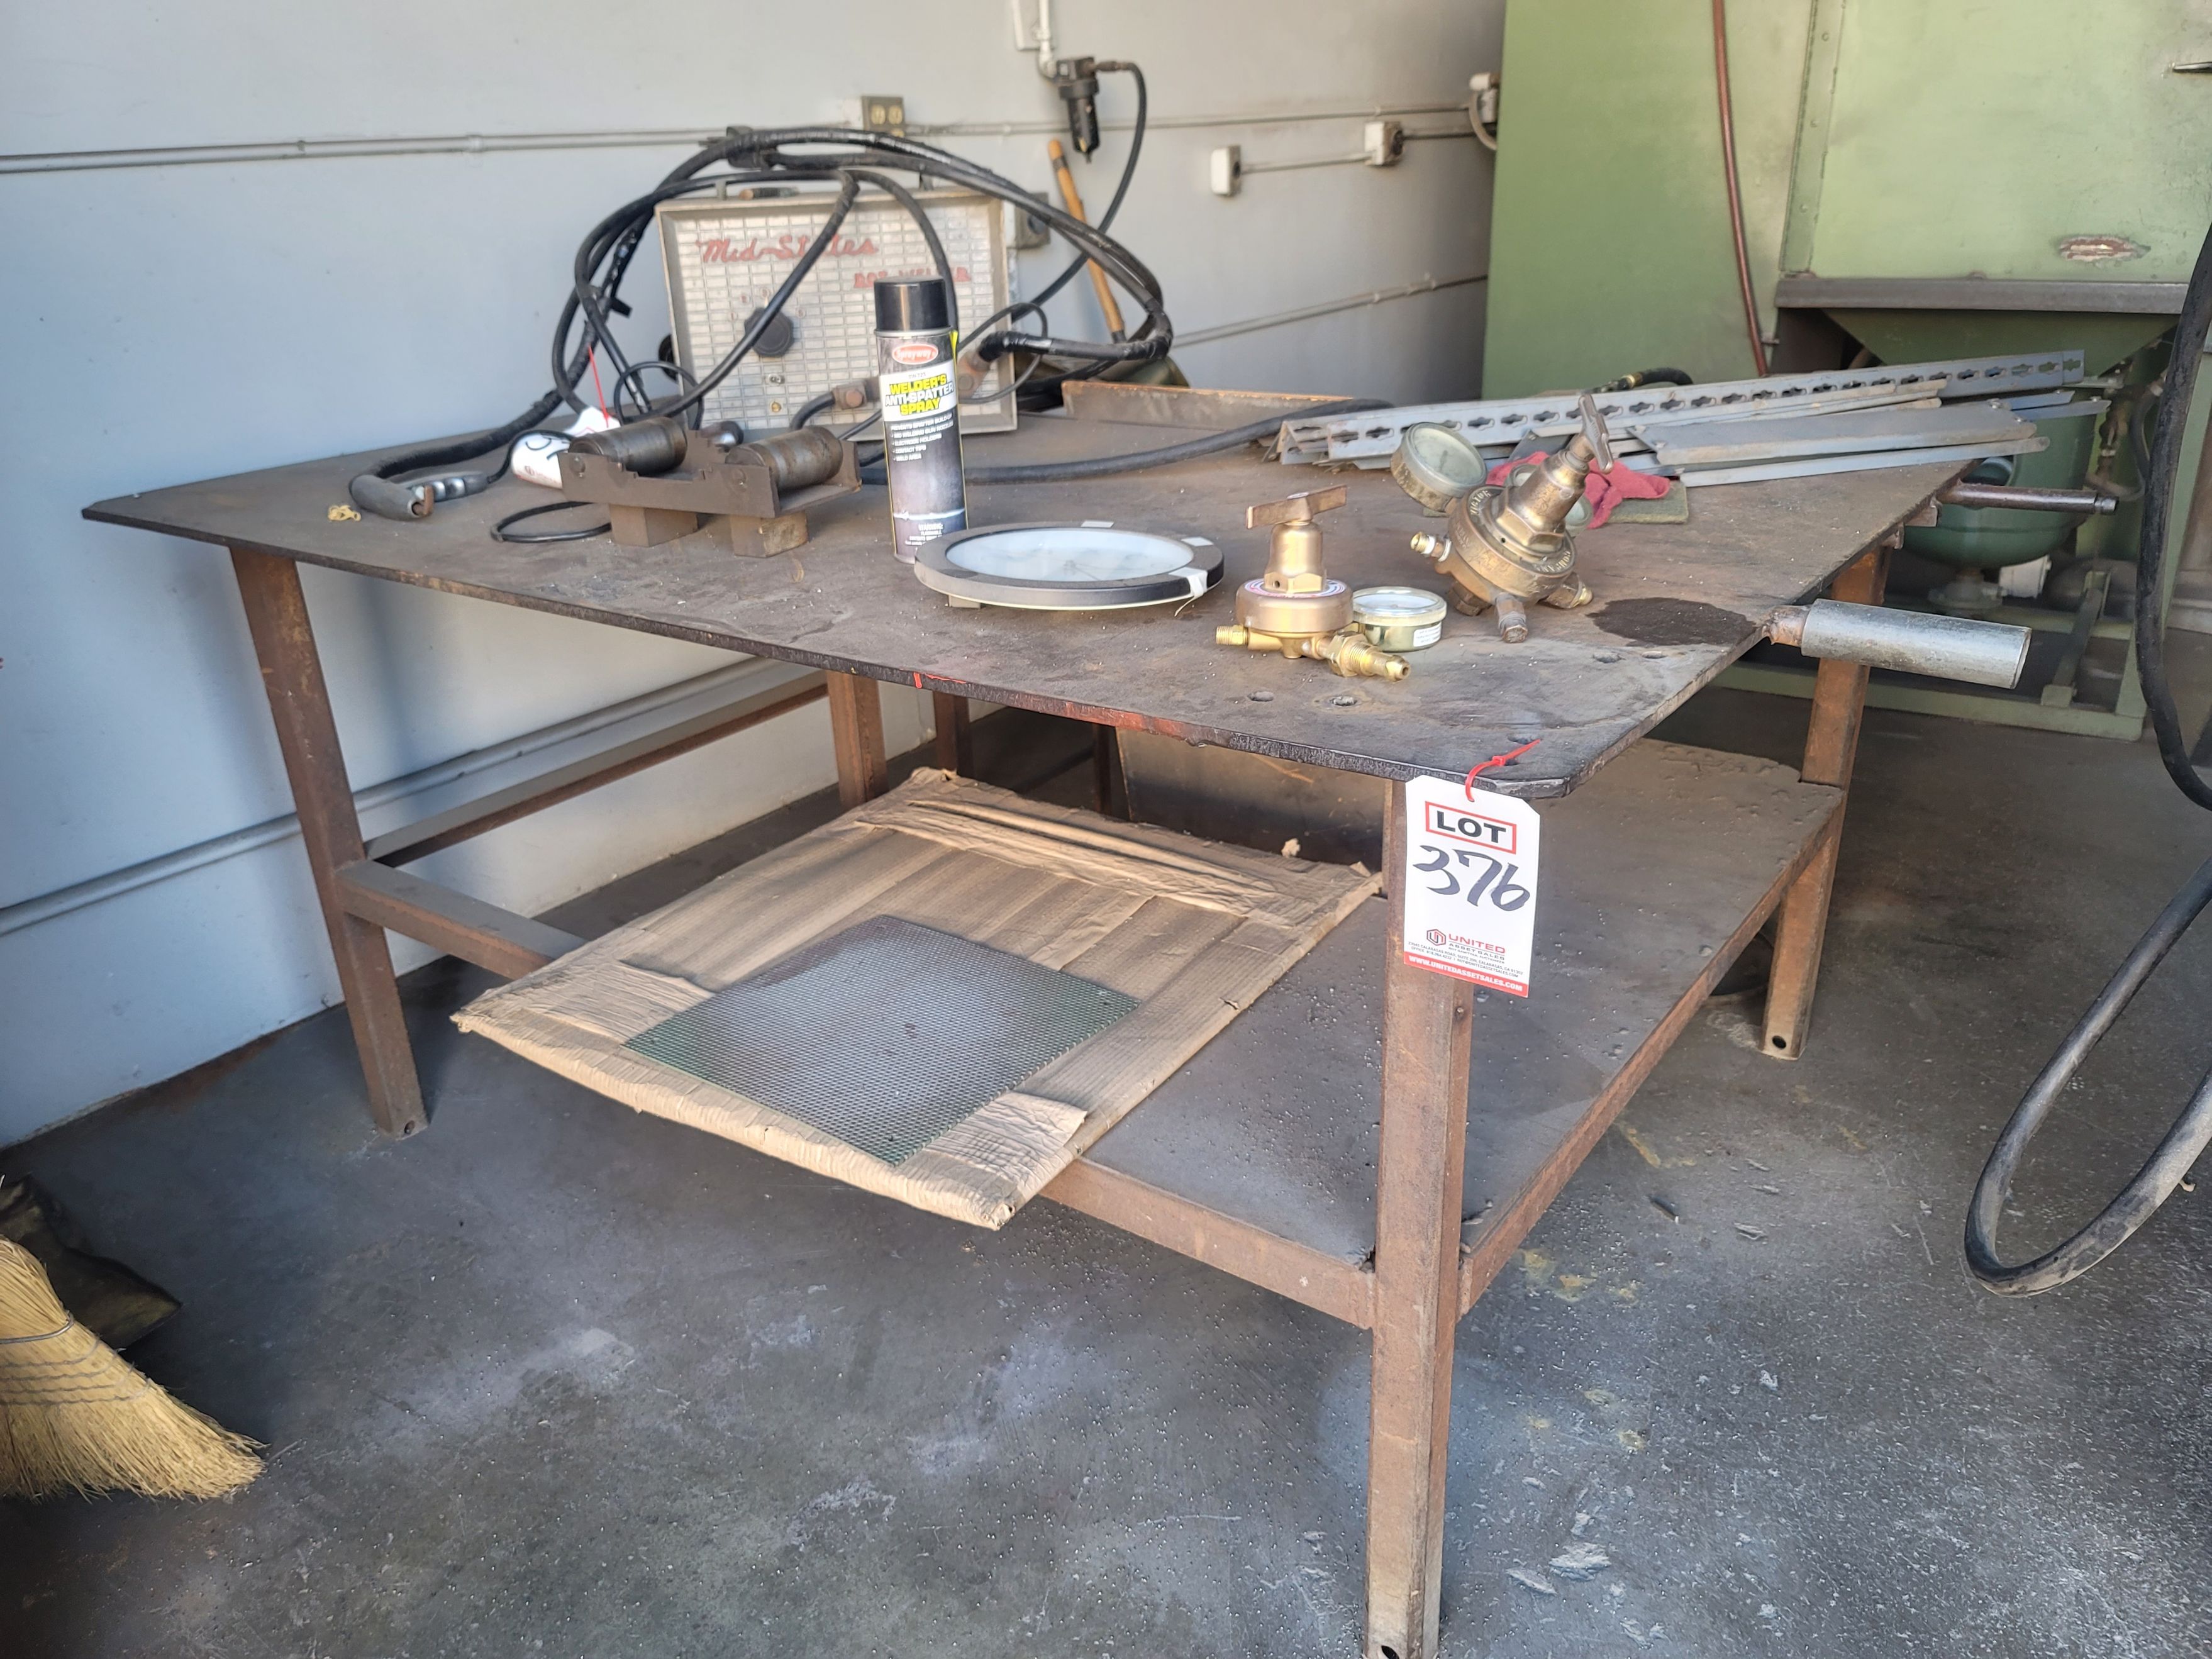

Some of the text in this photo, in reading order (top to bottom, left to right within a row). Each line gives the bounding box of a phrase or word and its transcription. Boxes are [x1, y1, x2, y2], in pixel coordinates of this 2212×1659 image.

[695, 234, 879, 263] Mid-Sttes
[886, 381, 955, 406] ANTI-SPATTER
[889, 374, 947, 395] WELDER'S
[900, 397, 941, 416] SPRAY
[1470, 490, 1492, 516] VICTOR
[1437, 810, 1506, 843] LOT
[1412, 845, 1531, 912] 376
[1448, 933, 1506, 953] UNITED
[1448, 943, 1505, 960] ASSET SALES
[1408, 955, 1523, 992] WWW.UNITEDASSETSALES.COM
